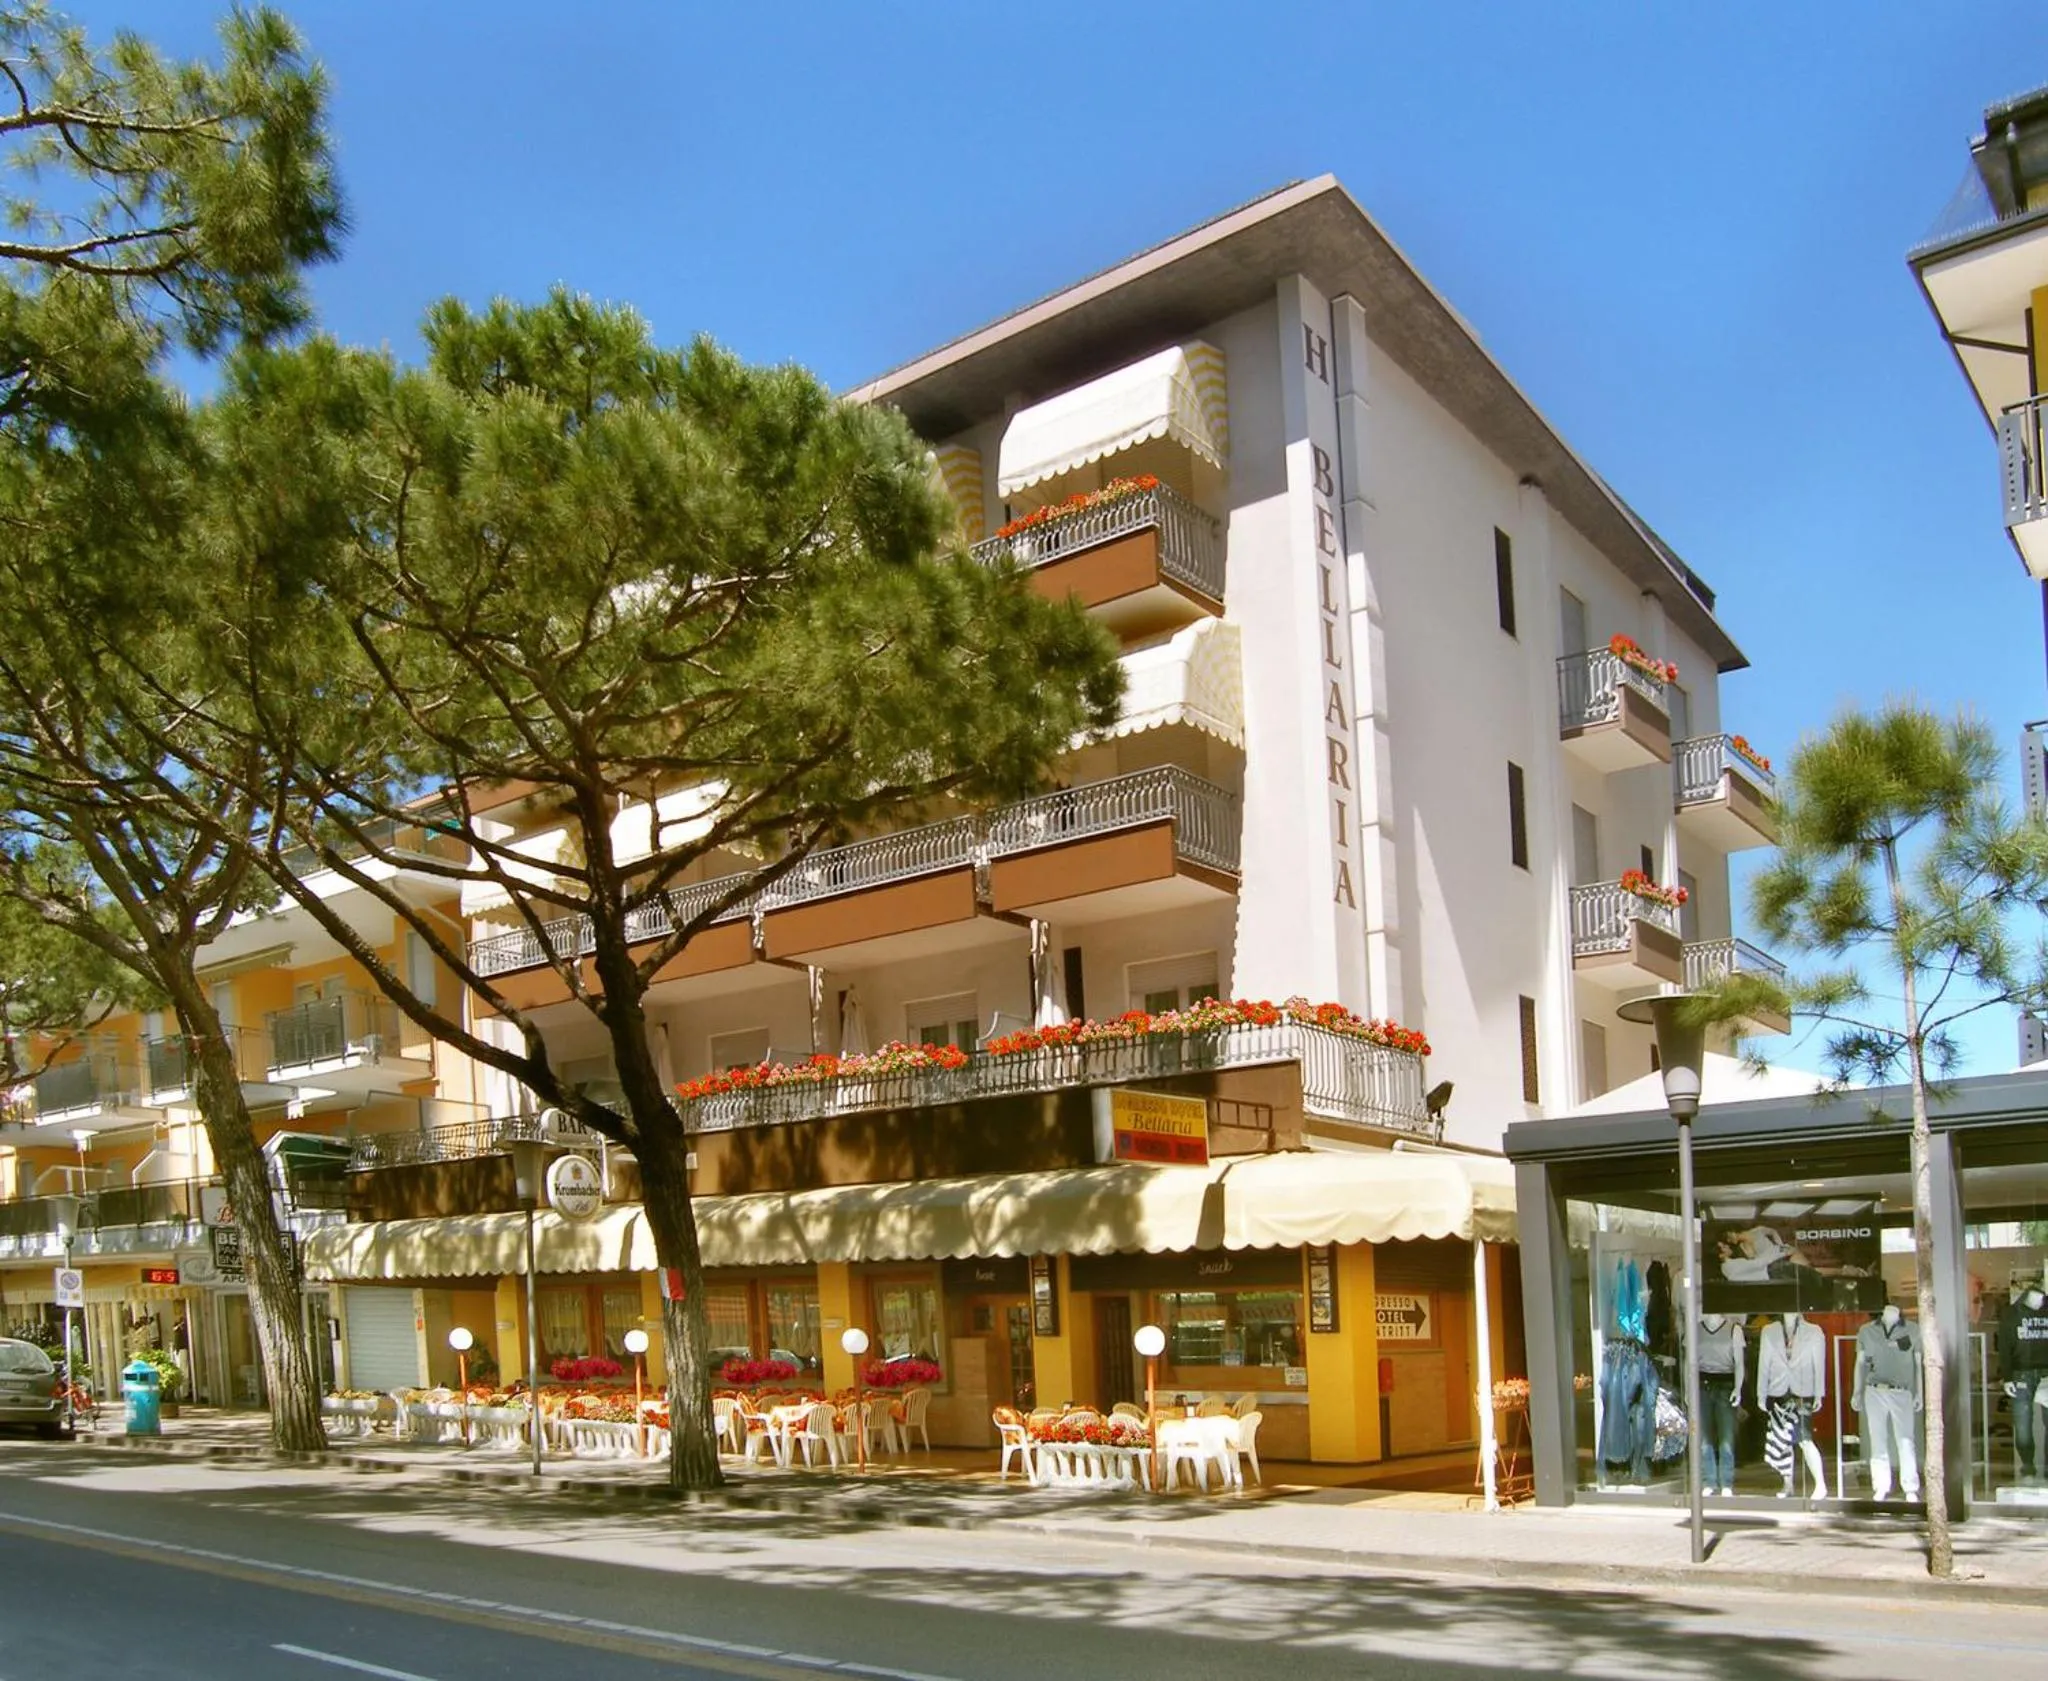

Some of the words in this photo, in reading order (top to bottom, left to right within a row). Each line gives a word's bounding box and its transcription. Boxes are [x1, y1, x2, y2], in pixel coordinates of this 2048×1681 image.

[1302, 321, 1329, 386] H
[1310, 443, 1357, 910] BELLARIA
[557, 1112, 588, 1135] BAR
[1128, 1112, 1192, 1135] Bellaria
[1795, 1227, 1872, 1240] SORBINO
[1198, 1257, 1234, 1275] Snack
[1376, 1310, 1406, 1323] OTEL
